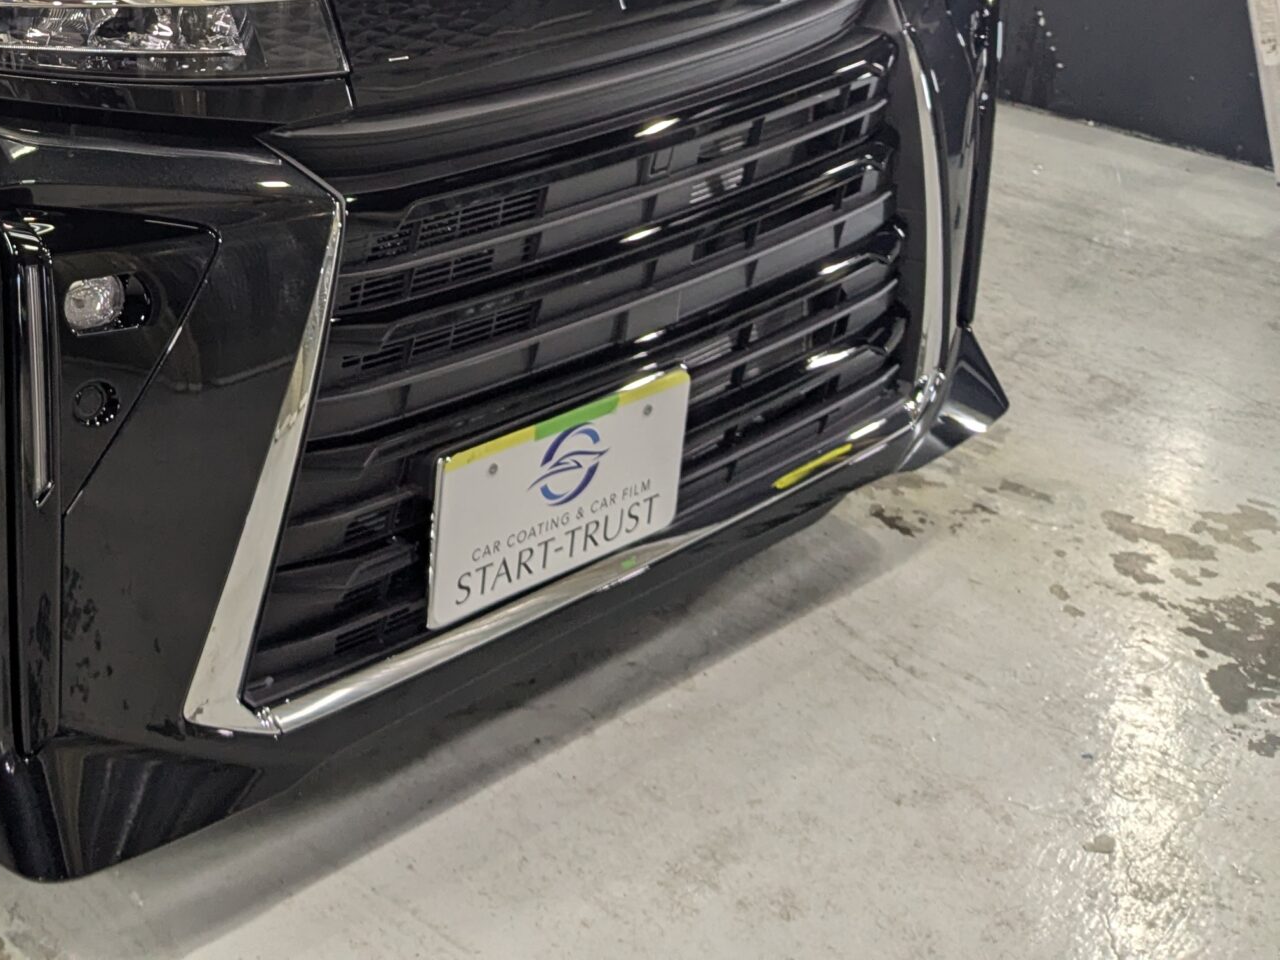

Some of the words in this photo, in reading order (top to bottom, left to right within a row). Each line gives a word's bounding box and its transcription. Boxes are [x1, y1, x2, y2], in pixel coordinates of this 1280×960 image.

[455, 493, 661, 606] START-TRUST
[471, 541, 501, 562] CAR
[506, 512, 570, 548] COATING
[575, 507, 585, 519] &
[590, 492, 617, 513] CAR
[622, 479, 651, 501] FILM
